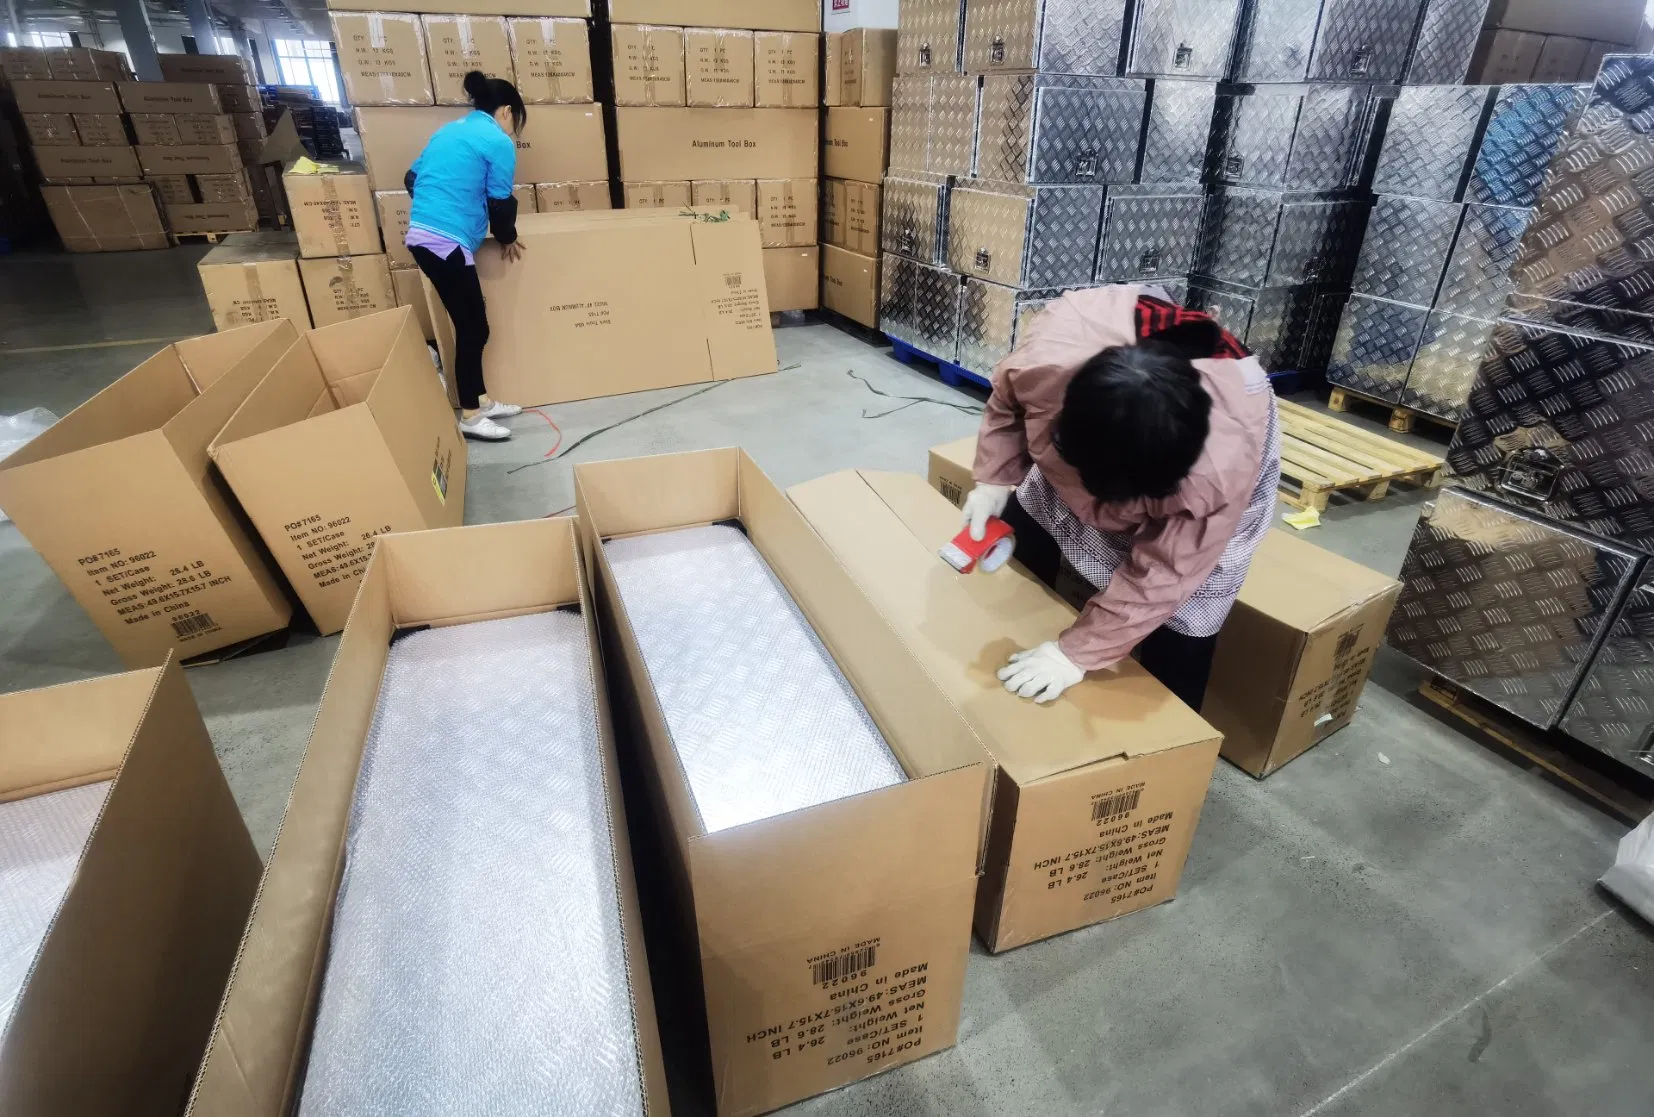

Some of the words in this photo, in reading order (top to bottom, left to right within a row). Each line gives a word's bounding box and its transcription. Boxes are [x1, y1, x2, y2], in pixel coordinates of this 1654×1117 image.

[516, 140, 532, 149] Box
[692, 139, 725, 148] Aluminum
[728, 139, 740, 148] Tool
[743, 139, 757, 148] Box
[284, 514, 322, 532] PO#7165
[290, 530, 309, 542] Item
[327, 516, 351, 529] 96022
[302, 551, 317, 561] Net
[319, 540, 350, 555] Weight:
[380, 525, 392, 534] LB
[306, 530, 345, 548] SET/Case
[78, 548, 121, 566] PO#7165
[87, 565, 108, 576] Item
[129, 551, 156, 564] 96022
[308, 558, 332, 570] Gross
[334, 546, 364, 561] Weight:
[102, 587, 119, 596] Net
[121, 576, 156, 590] Weight:
[191, 560, 204, 570] LB
[106, 565, 150, 583] SET/Case
[208, 575, 232, 587] INCH
[110, 594, 138, 606] Gross
[198, 570, 212, 579] LB
[319, 577, 340, 588] Made
[124, 613, 149, 625] Made
[152, 609, 162, 618] in
[164, 601, 190, 613] China
[1096, 812, 1130, 827] 96022
[1133, 820, 1142, 828] in
[1147, 811, 1174, 824] Made
[1099, 824, 1128, 838] China
[1137, 837, 1166, 850] Gross
[1096, 846, 1133, 863] Weight:
[1147, 849, 1163, 858] Net
[1034, 856, 1061, 870] INCH
[1069, 860, 1091, 872] 28.6
[1106, 855, 1142, 871] Weight:
[1049, 867, 1064, 878] LB
[1067, 871, 1088, 883] 26.4
[1101, 865, 1148, 883] SET/Case
[1136, 872, 1156, 883] Item
[1048, 879, 1062, 890] LB
[1083, 887, 1111, 901] 96022
[1110, 884, 1154, 904] PO#7165
[854, 937, 880, 948] MADE
[806, 950, 836, 964] CHINA
[894, 962, 928, 980] Made
[822, 970, 867, 989] 96022
[875, 976, 887, 986] in
[829, 982, 868, 1001] China
[888, 989, 926, 1006] Gross
[788, 975, 927, 1029] MEAS:49.6X15.7X15.7
[904, 1001, 925, 1012] Net
[832, 1004, 882, 1026] Weight:
[849, 1010, 898, 1032] Weight:
[918, 1014, 924, 1022] 1
[746, 1025, 783, 1043] INCH
[797, 1024, 825, 1039] 28.6
[847, 1019, 907, 1045] SET/Case
[896, 1026, 923, 1040] Item
[770, 1035, 789, 1048] LB
[798, 1036, 825, 1051] 26.4
[867, 1037, 890, 1050] NO:
[772, 1047, 791, 1060] LB
[827, 1047, 864, 1066] 96022
[866, 1037, 921, 1063] PO#7165
